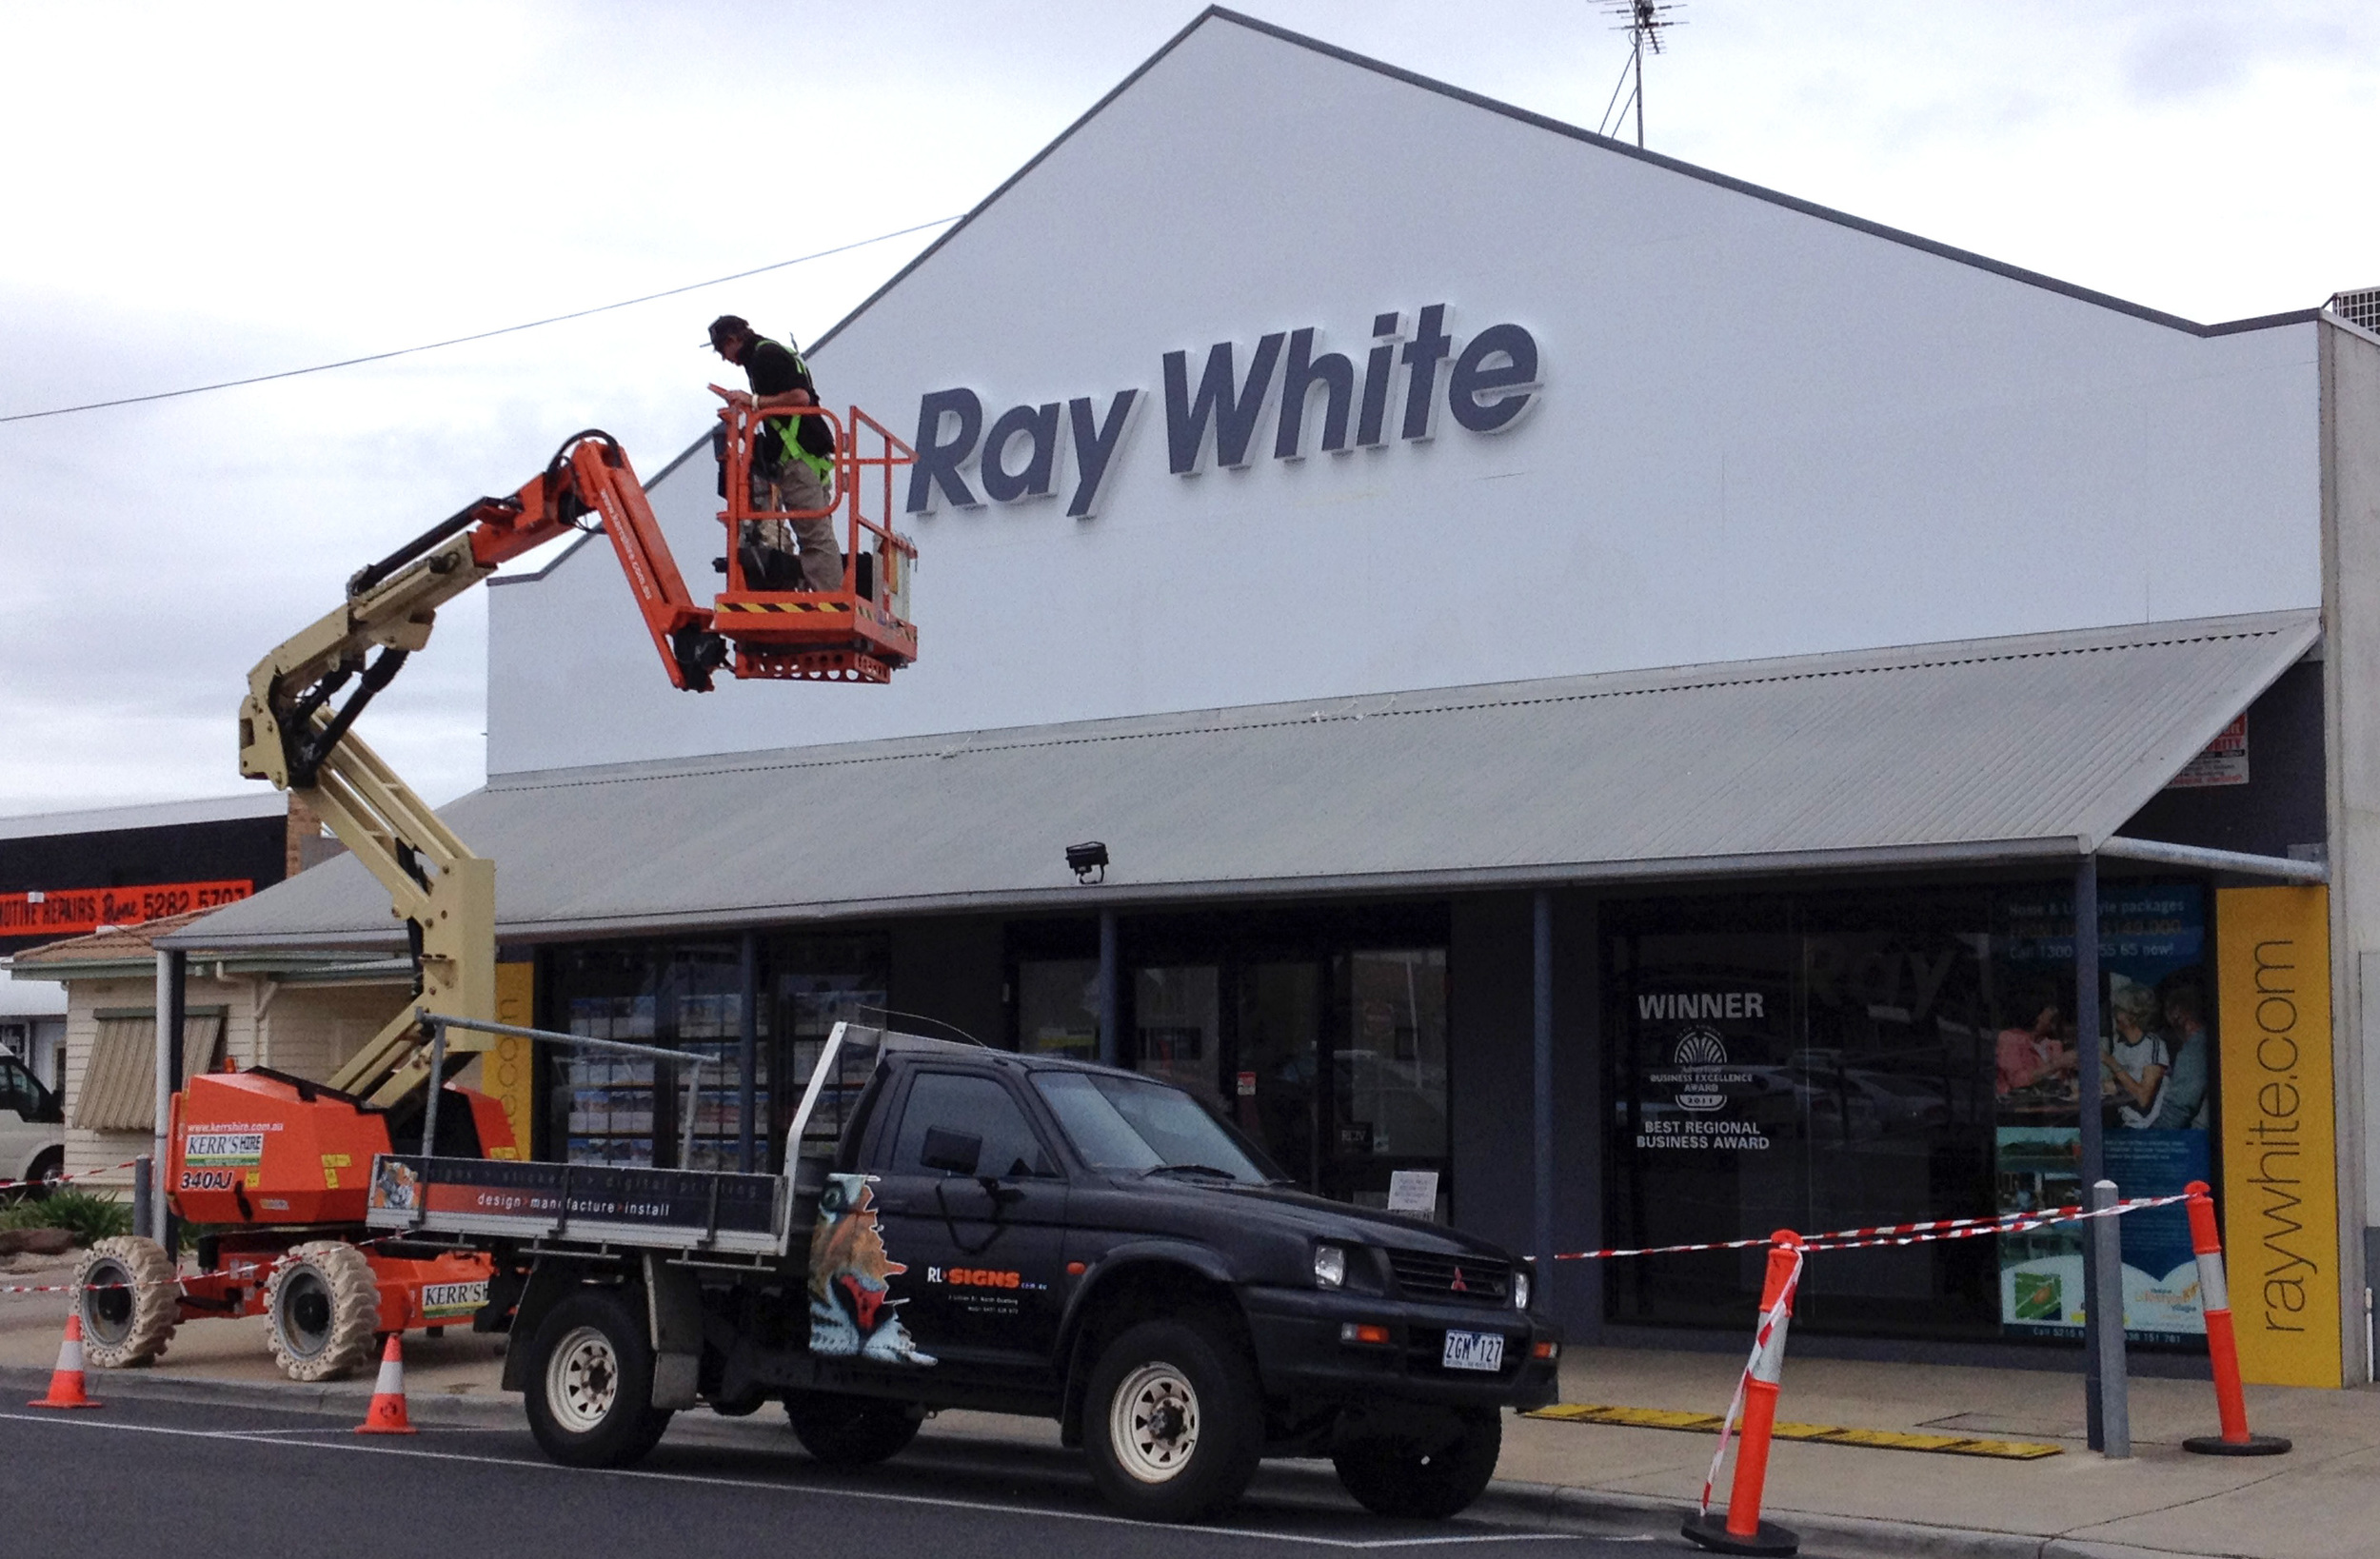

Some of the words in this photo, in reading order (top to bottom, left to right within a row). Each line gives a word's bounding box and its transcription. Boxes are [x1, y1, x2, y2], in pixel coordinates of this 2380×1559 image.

[905, 387, 1142, 518] Ray
[1162, 303, 1540, 474] White
[43, 896, 96, 923] REPAIRS
[143, 891, 189, 918] 5282
[2121, 899, 2185, 915] packages
[1638, 993, 1765, 1019] WINNER
[187, 1122, 284, 1133] www.kerrshire.com.au
[1645, 1120, 1681, 1134] BEST
[1685, 1121, 1761, 1135] REGIONAL
[2246, 939, 2317, 1332] raywhite.com
[1636, 1135, 1709, 1149] BUSINESS
[1713, 1136, 1771, 1150] AWARD
[181, 1172, 233, 1190] 340AJ
[477, 1192, 523, 1210] design
[624, 1201, 671, 1216] install
[1446, 1335, 1472, 1360] ZGM
[1480, 1339, 1502, 1363] 127
